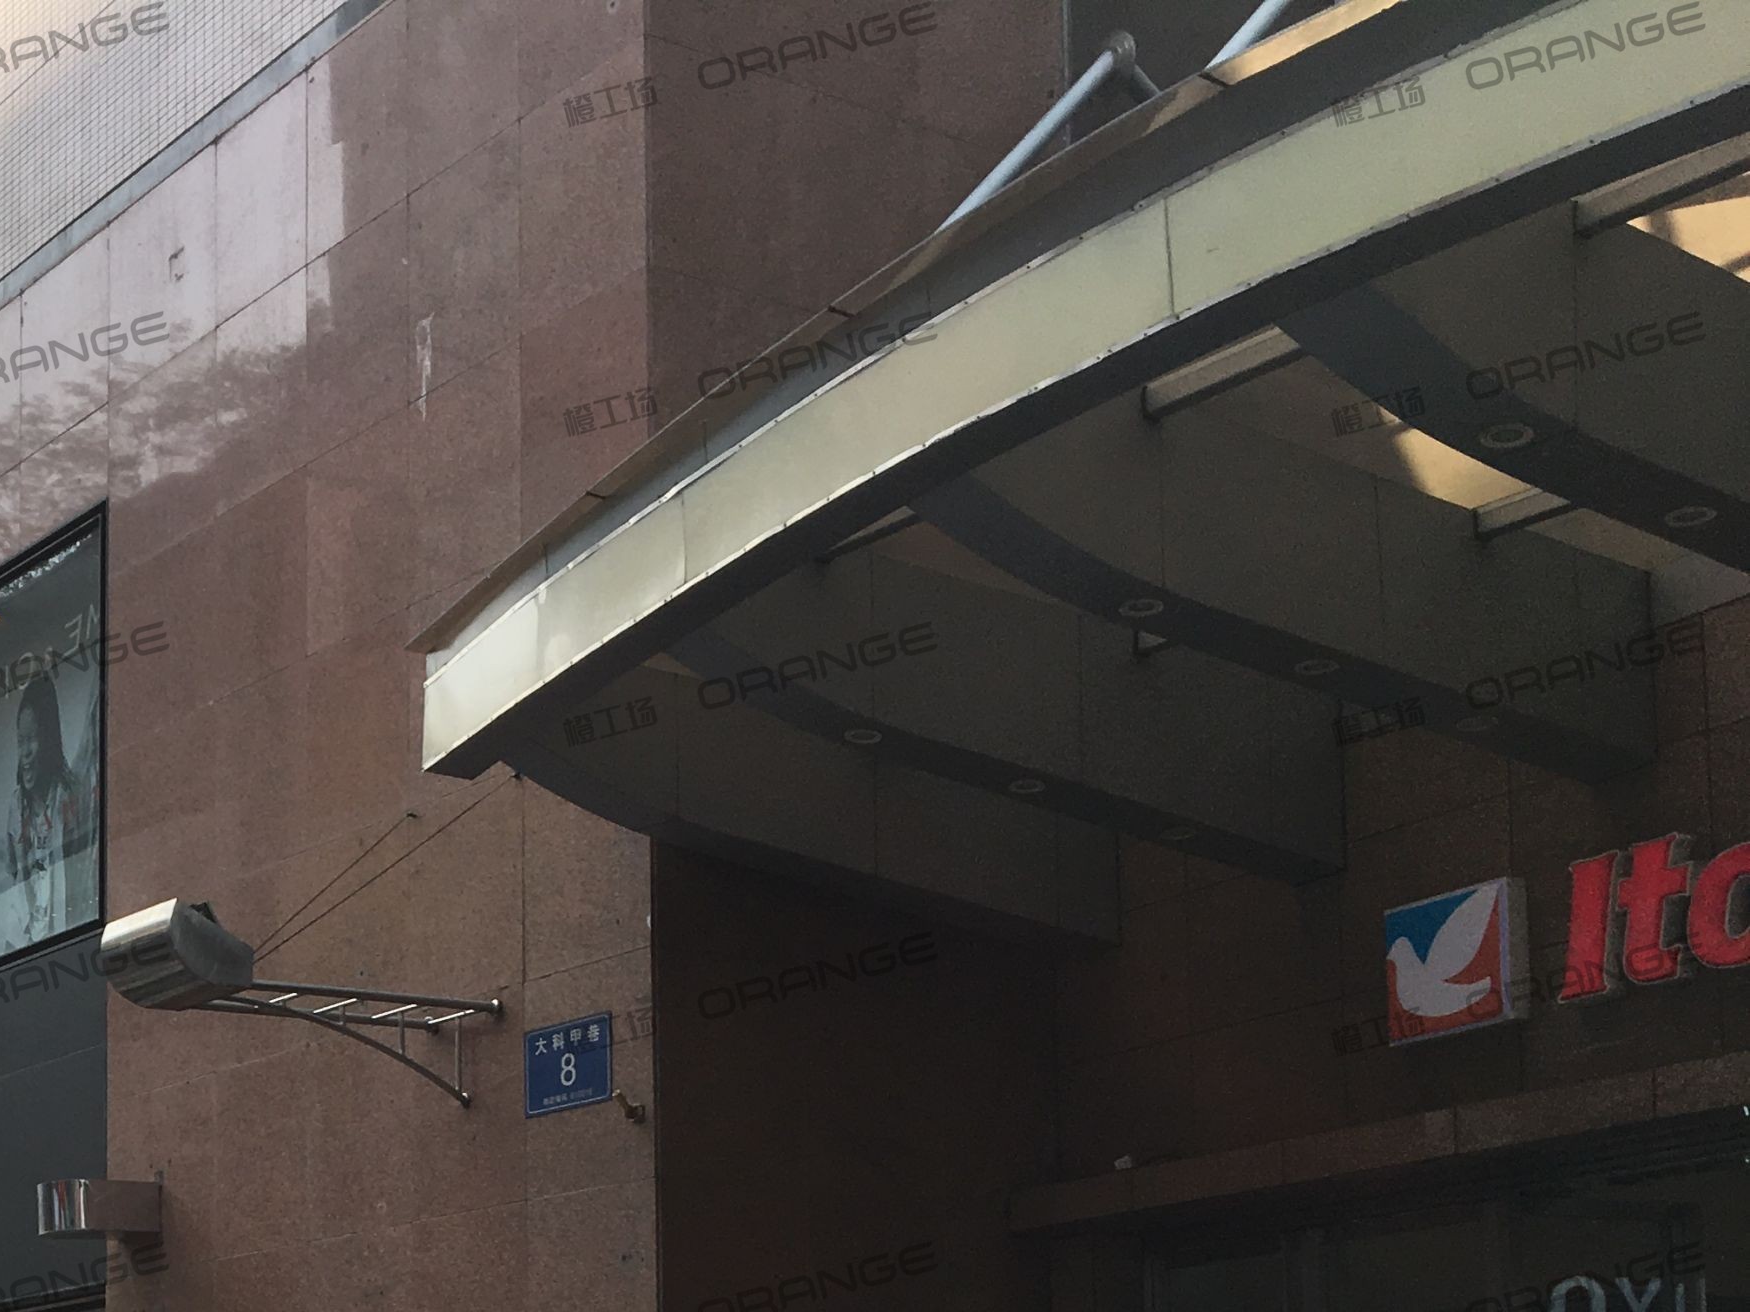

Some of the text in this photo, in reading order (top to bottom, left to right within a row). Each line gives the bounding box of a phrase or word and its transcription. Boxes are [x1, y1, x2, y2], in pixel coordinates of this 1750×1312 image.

[535, 1024, 600, 1056] 大科甲巷
[560, 1052, 577, 1086] 8
